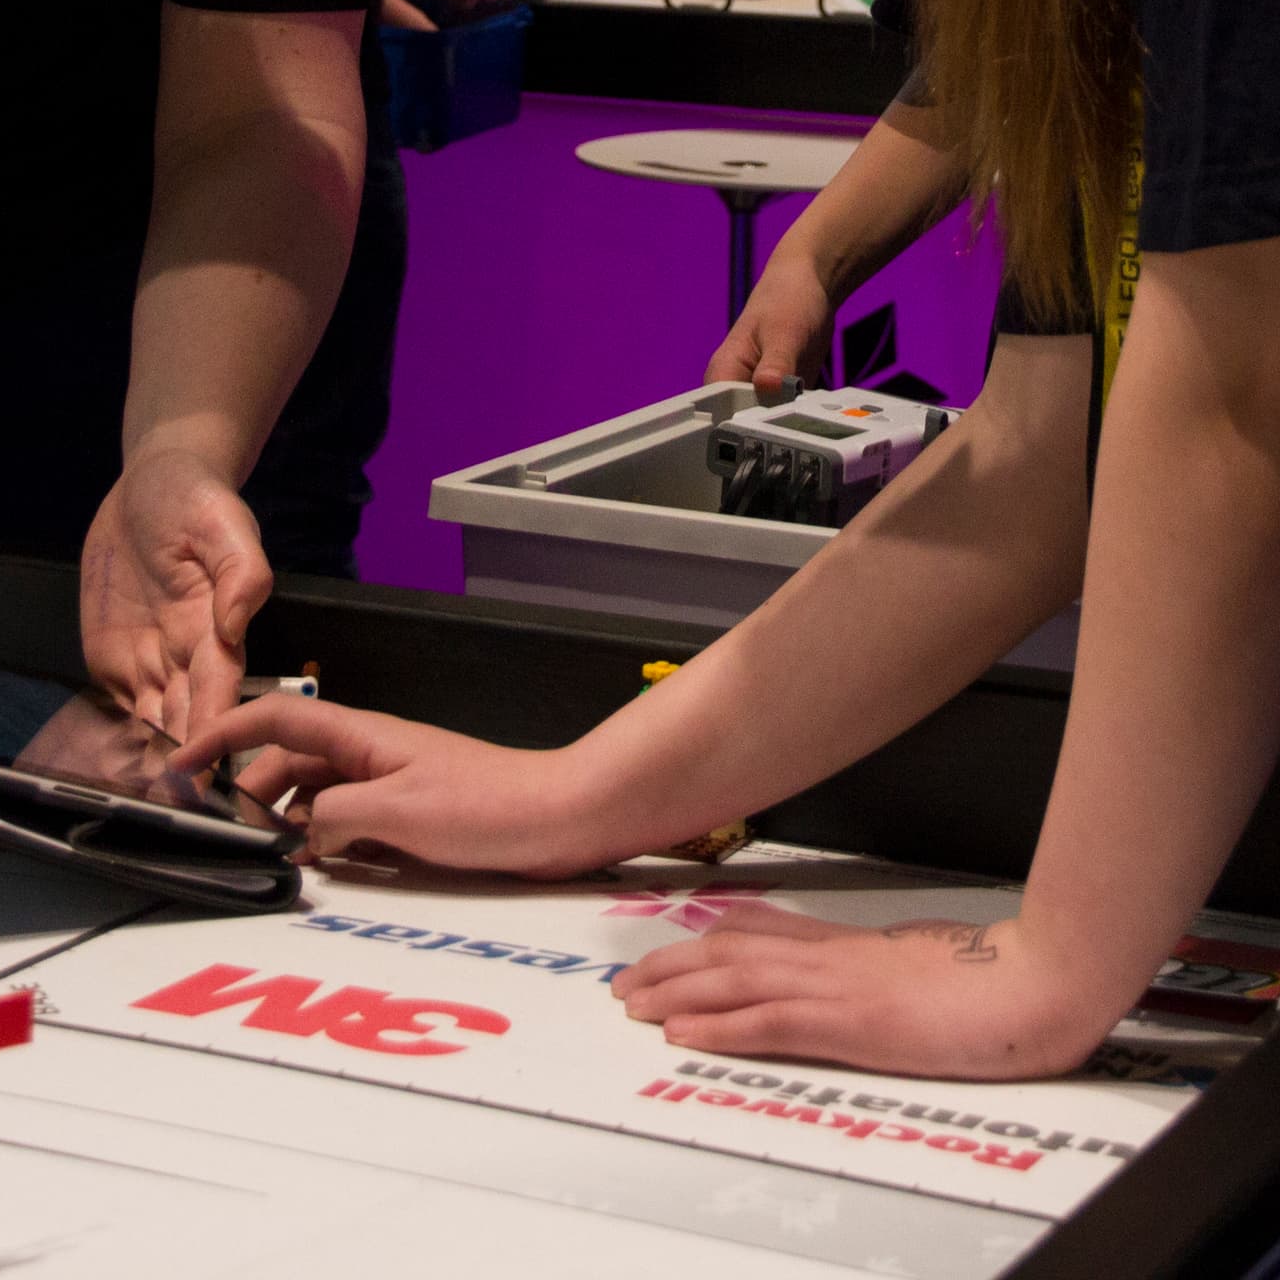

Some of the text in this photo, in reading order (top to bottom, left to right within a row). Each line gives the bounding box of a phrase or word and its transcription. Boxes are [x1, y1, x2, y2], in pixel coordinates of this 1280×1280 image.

[128, 962, 512, 1056] 3M
[635, 1078, 1044, 1172] Rockwell
[675, 1060, 1140, 1158] utomation
